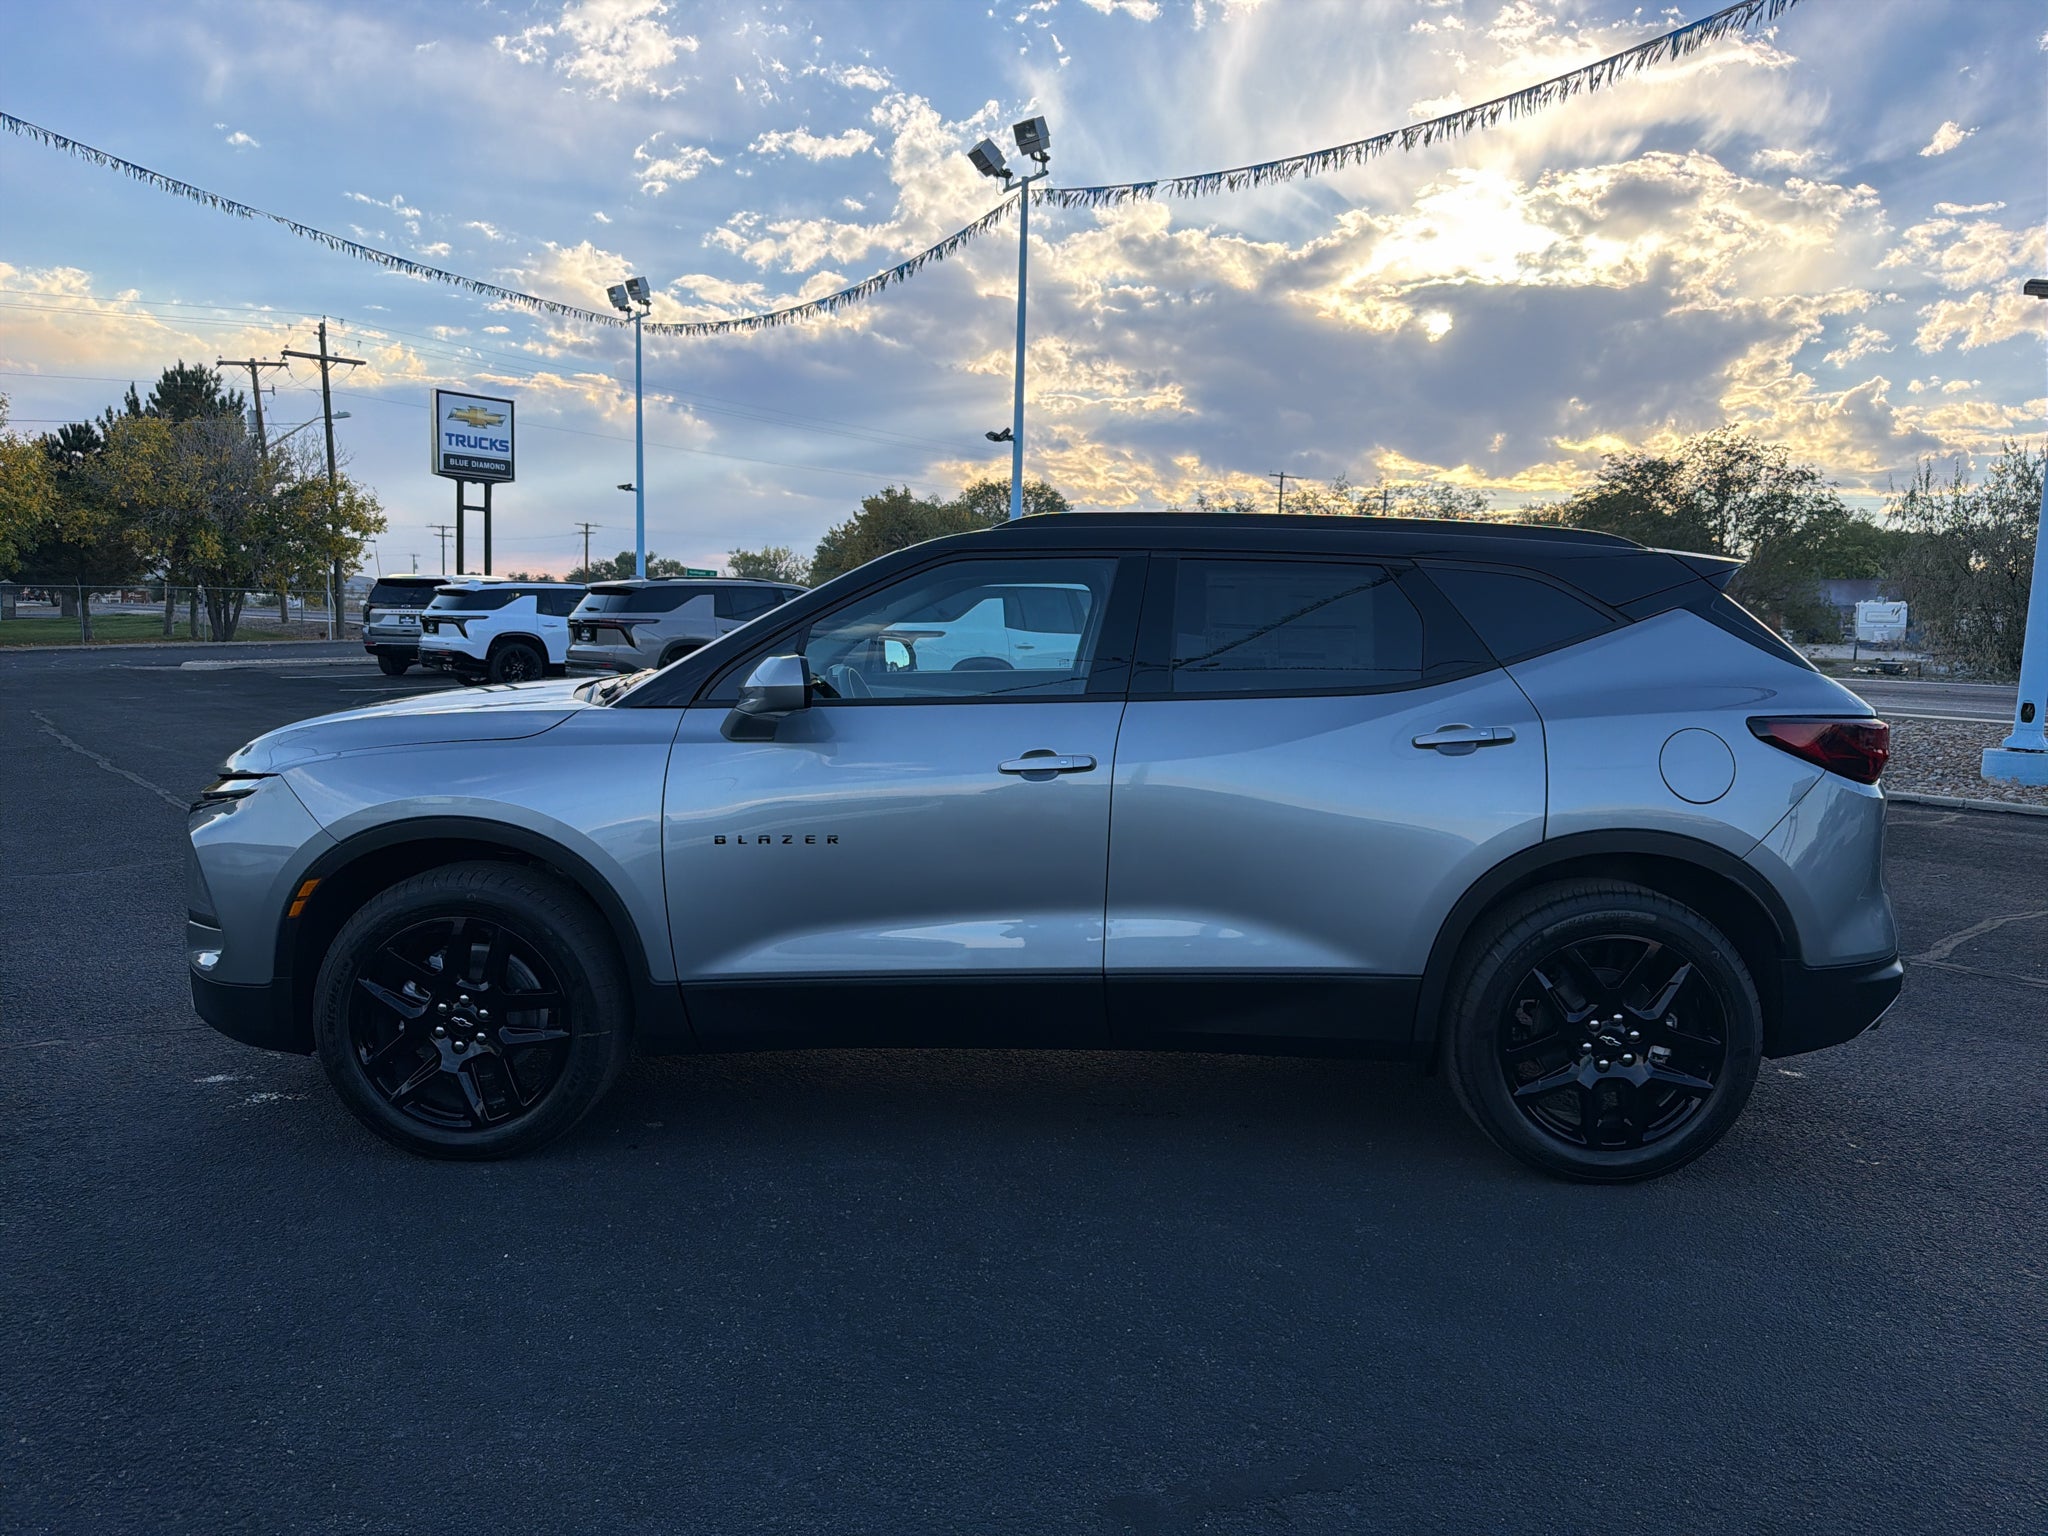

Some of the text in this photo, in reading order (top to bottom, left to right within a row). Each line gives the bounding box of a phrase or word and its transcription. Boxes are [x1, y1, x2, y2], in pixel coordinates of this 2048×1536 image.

[445, 432, 509, 452] TRUCKS
[449, 458, 506, 471] BLUE DIAMOND
[714, 834, 840, 845] BLAZER
